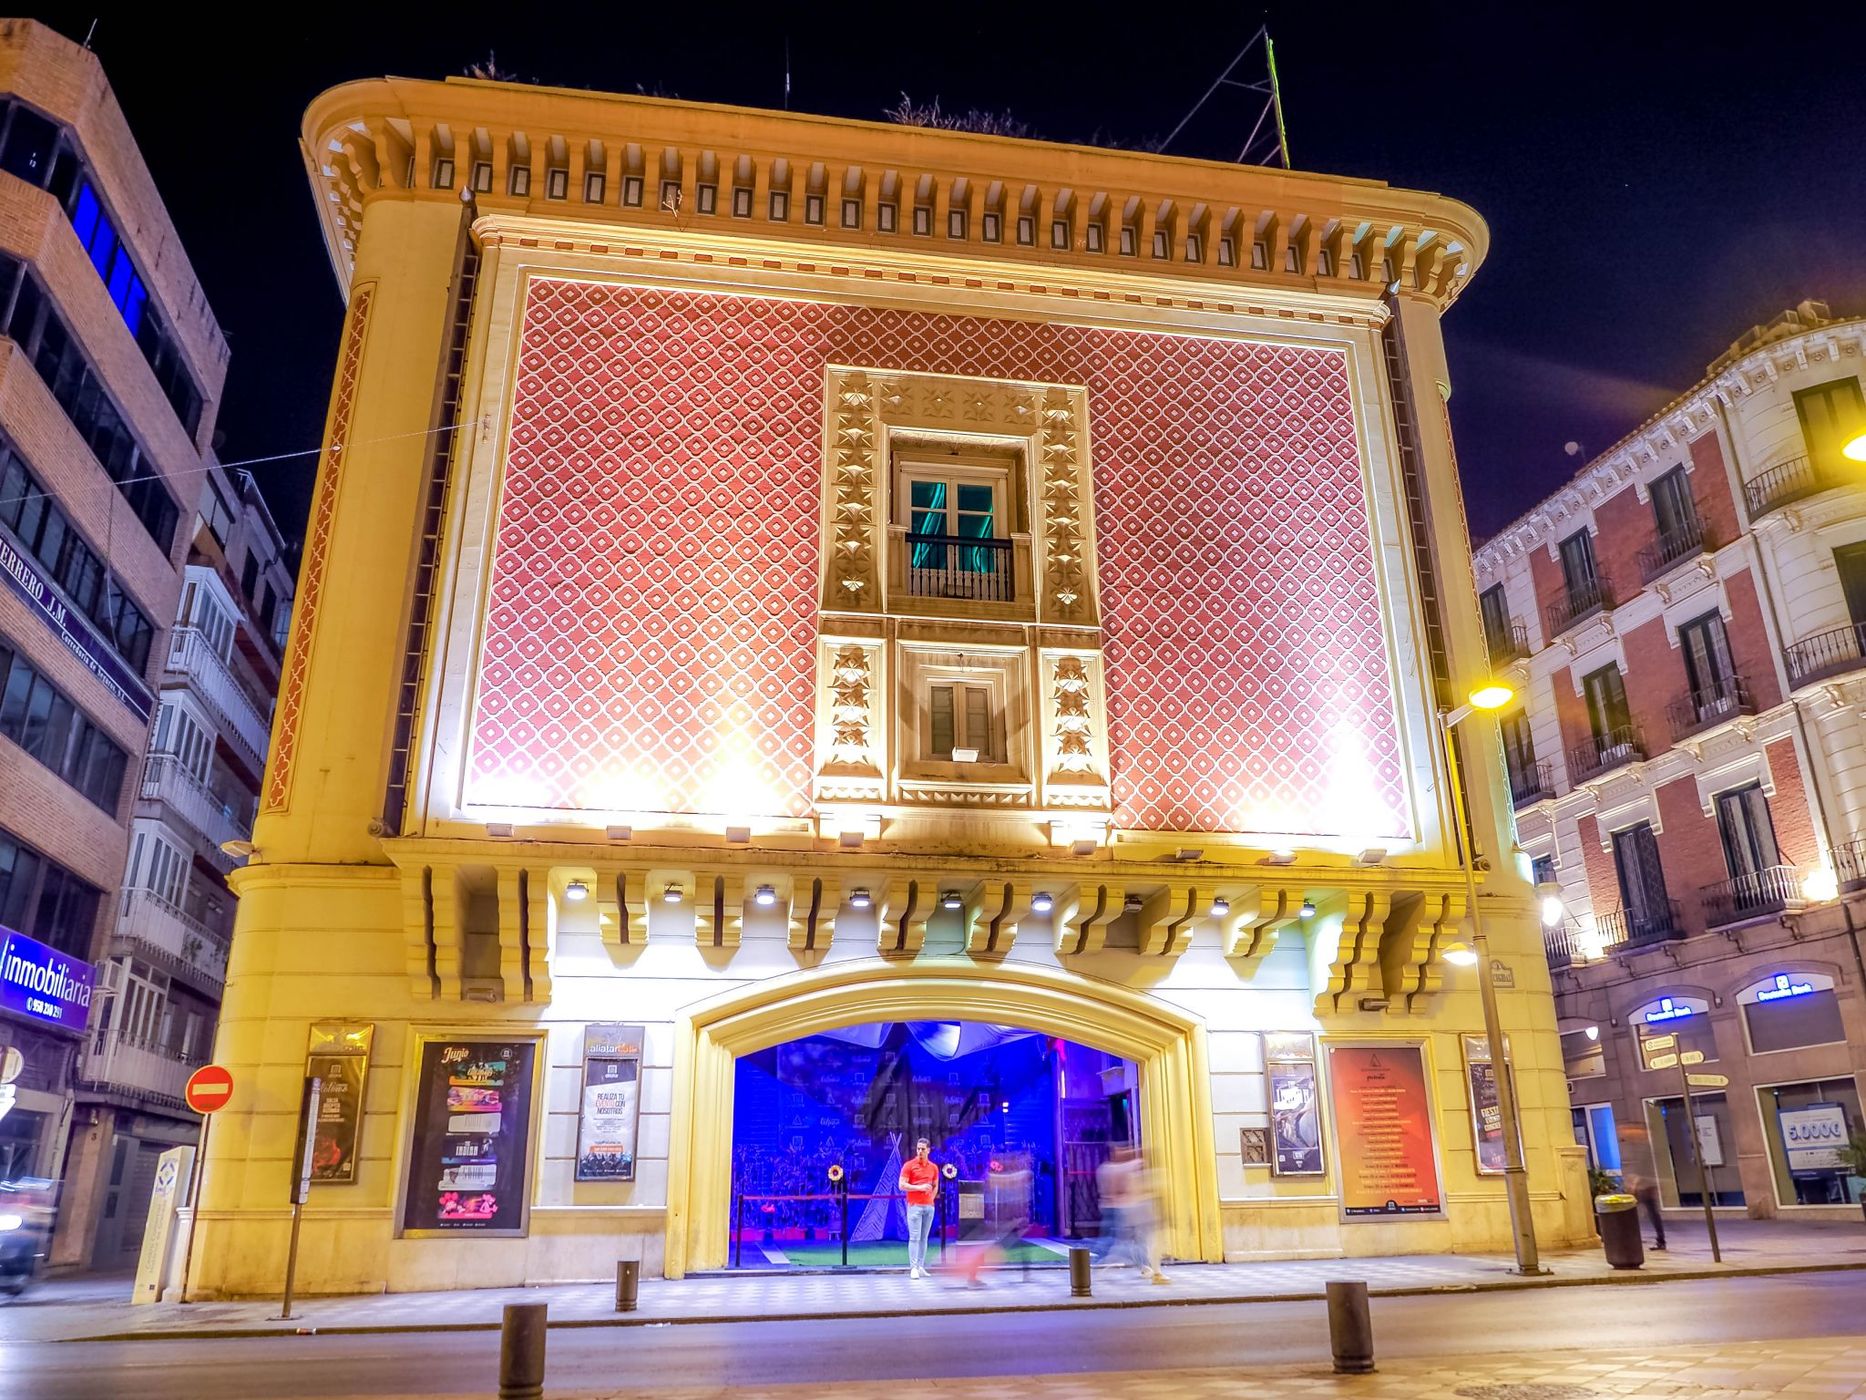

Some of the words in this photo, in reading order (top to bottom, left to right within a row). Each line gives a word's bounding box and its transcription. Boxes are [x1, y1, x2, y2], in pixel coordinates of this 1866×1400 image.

[0, 541, 44, 600] ERRERO
[4, 943, 91, 1008] inmobiliaria
[441, 1047, 470, 1064] Junio
